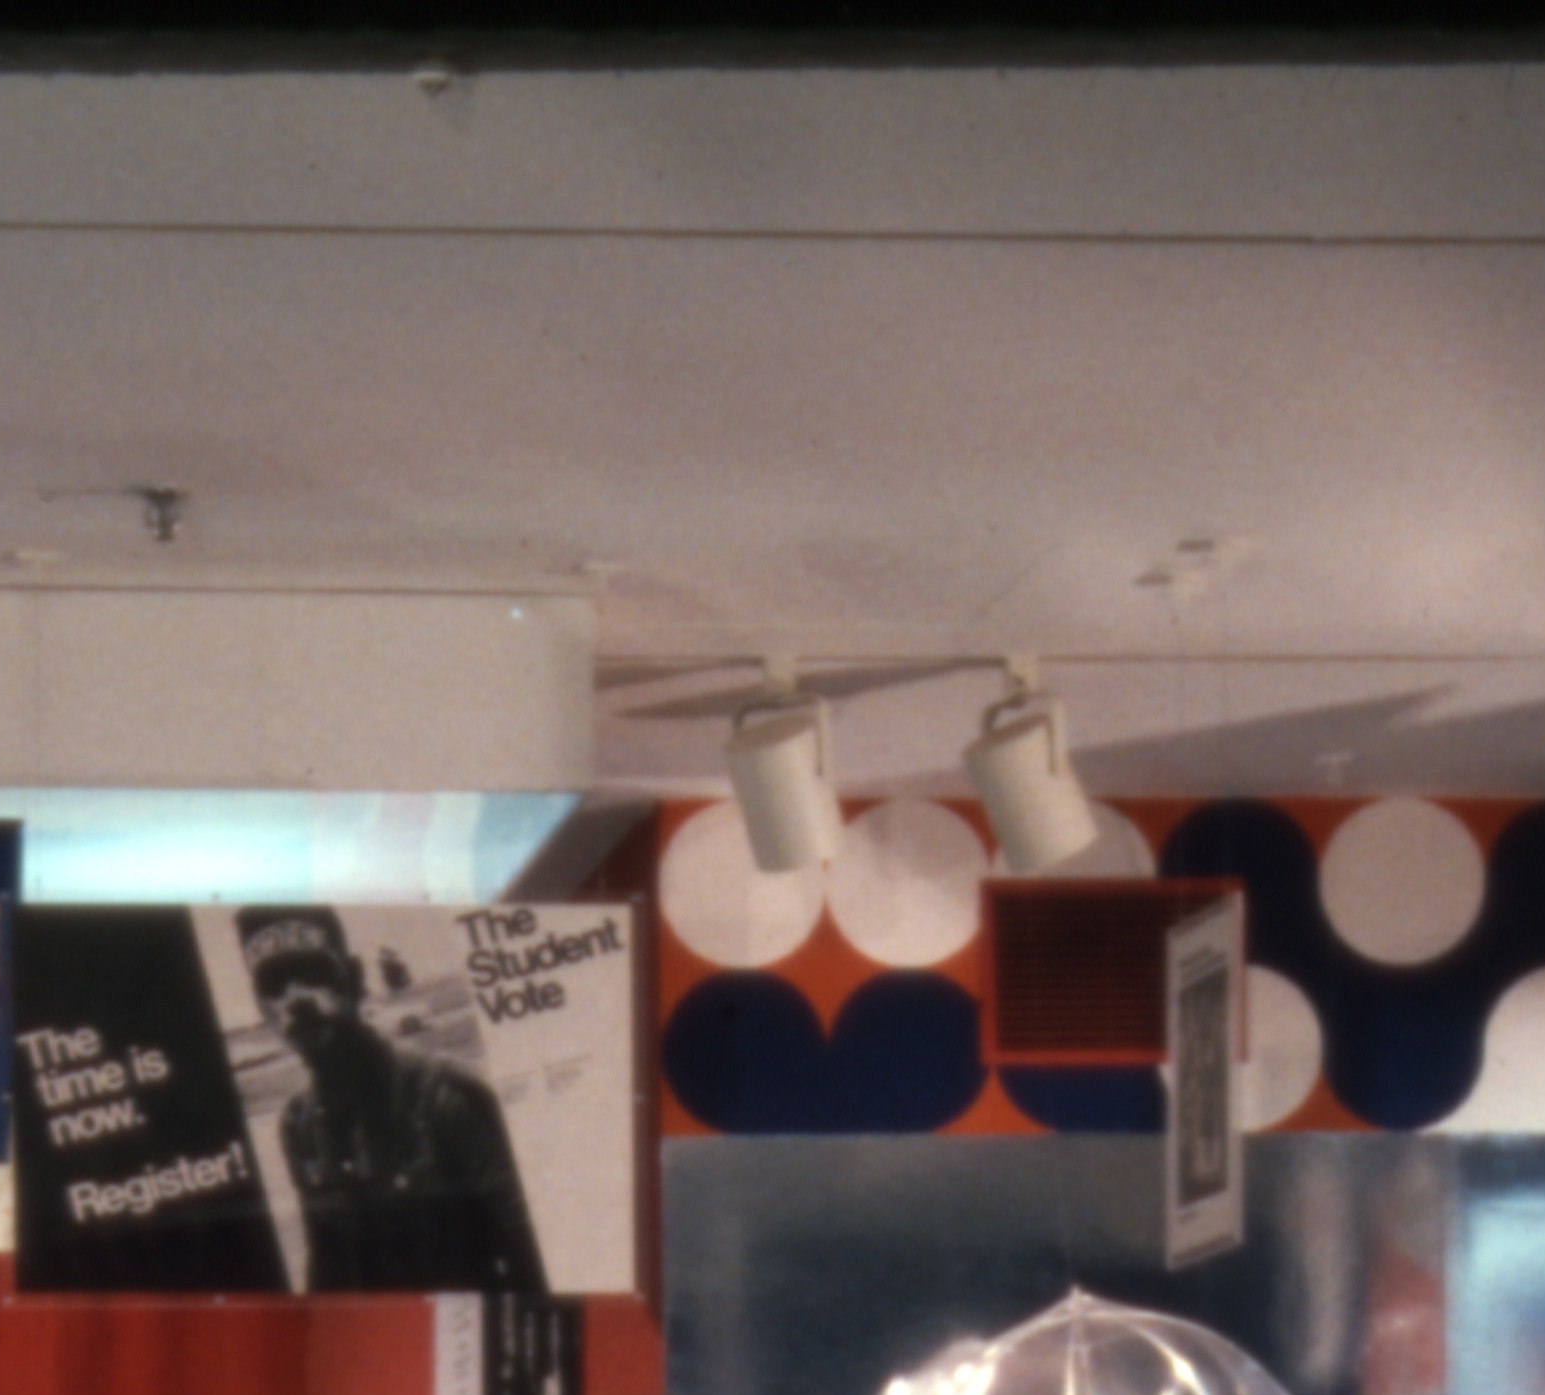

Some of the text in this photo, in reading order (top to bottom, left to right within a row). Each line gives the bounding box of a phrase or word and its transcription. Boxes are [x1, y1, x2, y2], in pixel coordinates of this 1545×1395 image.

[457, 906, 539, 952] The
[466, 917, 624, 990] Student
[476, 976, 566, 1025] Vote
[18, 1025, 102, 1072] The
[34, 1045, 170, 1108] time is
[48, 1099, 146, 1147] now.
[67, 1142, 250, 1222] Register!
